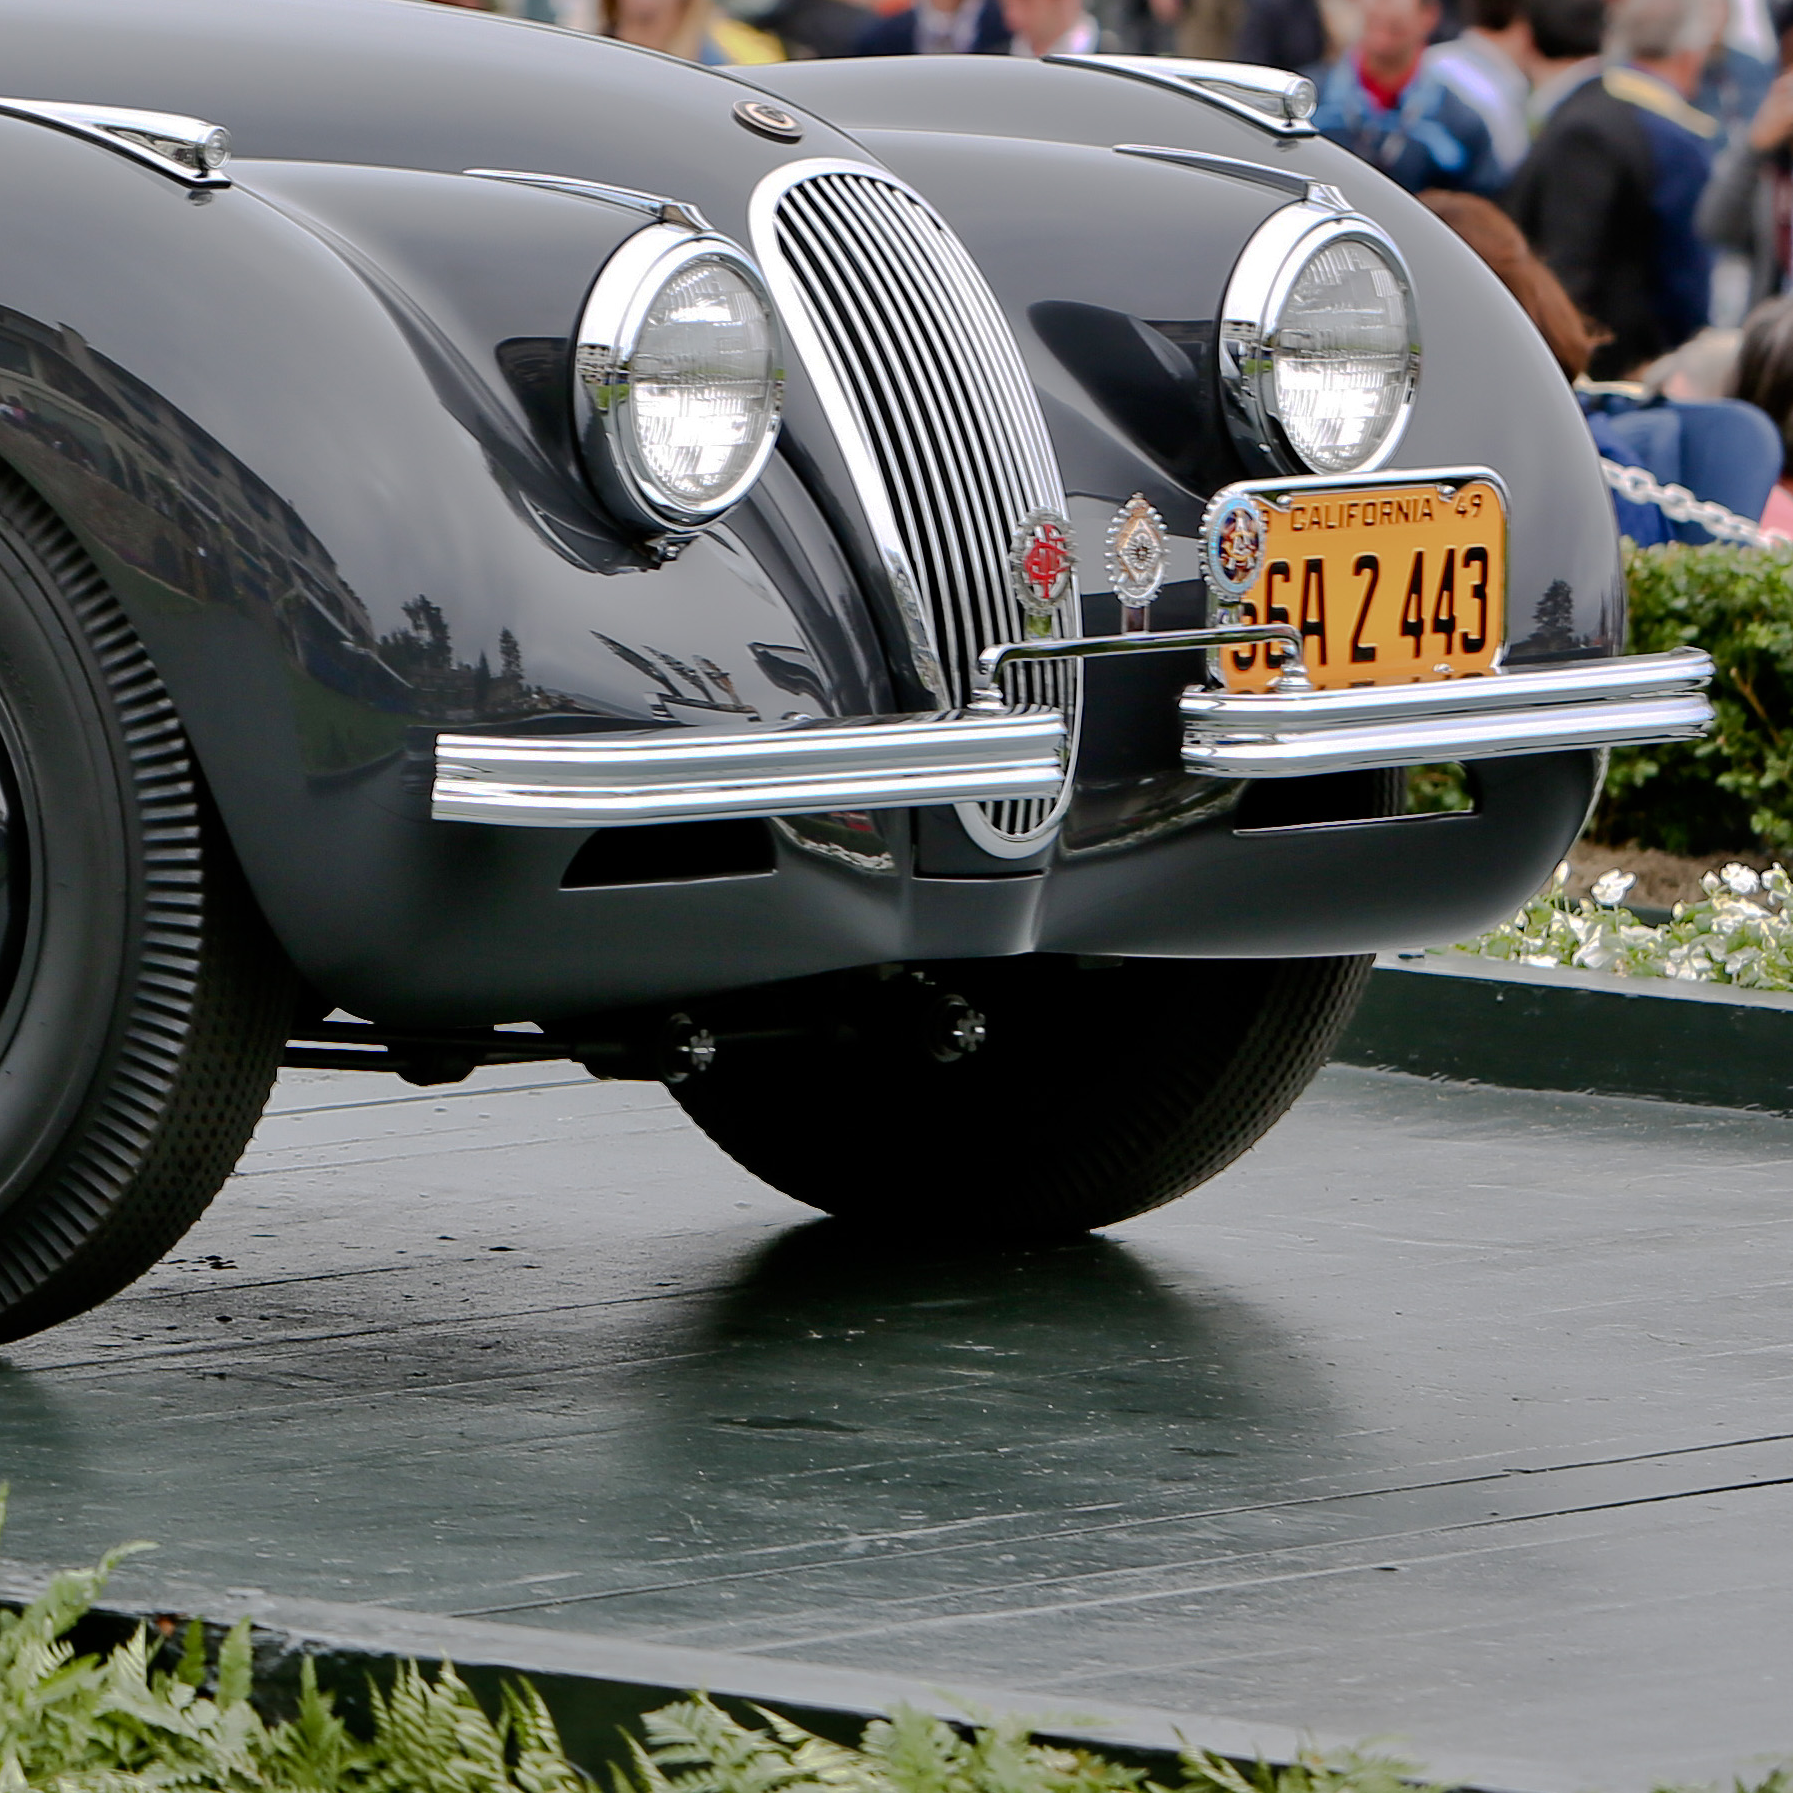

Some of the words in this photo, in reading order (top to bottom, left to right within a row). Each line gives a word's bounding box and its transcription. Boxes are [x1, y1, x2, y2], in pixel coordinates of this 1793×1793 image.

[1291, 497, 1433, 531] CALIFORNIA
[1455, 493, 1483, 518] 49
[1348, 552, 1381, 663] 2
[1400, 546, 1489, 659] 443
